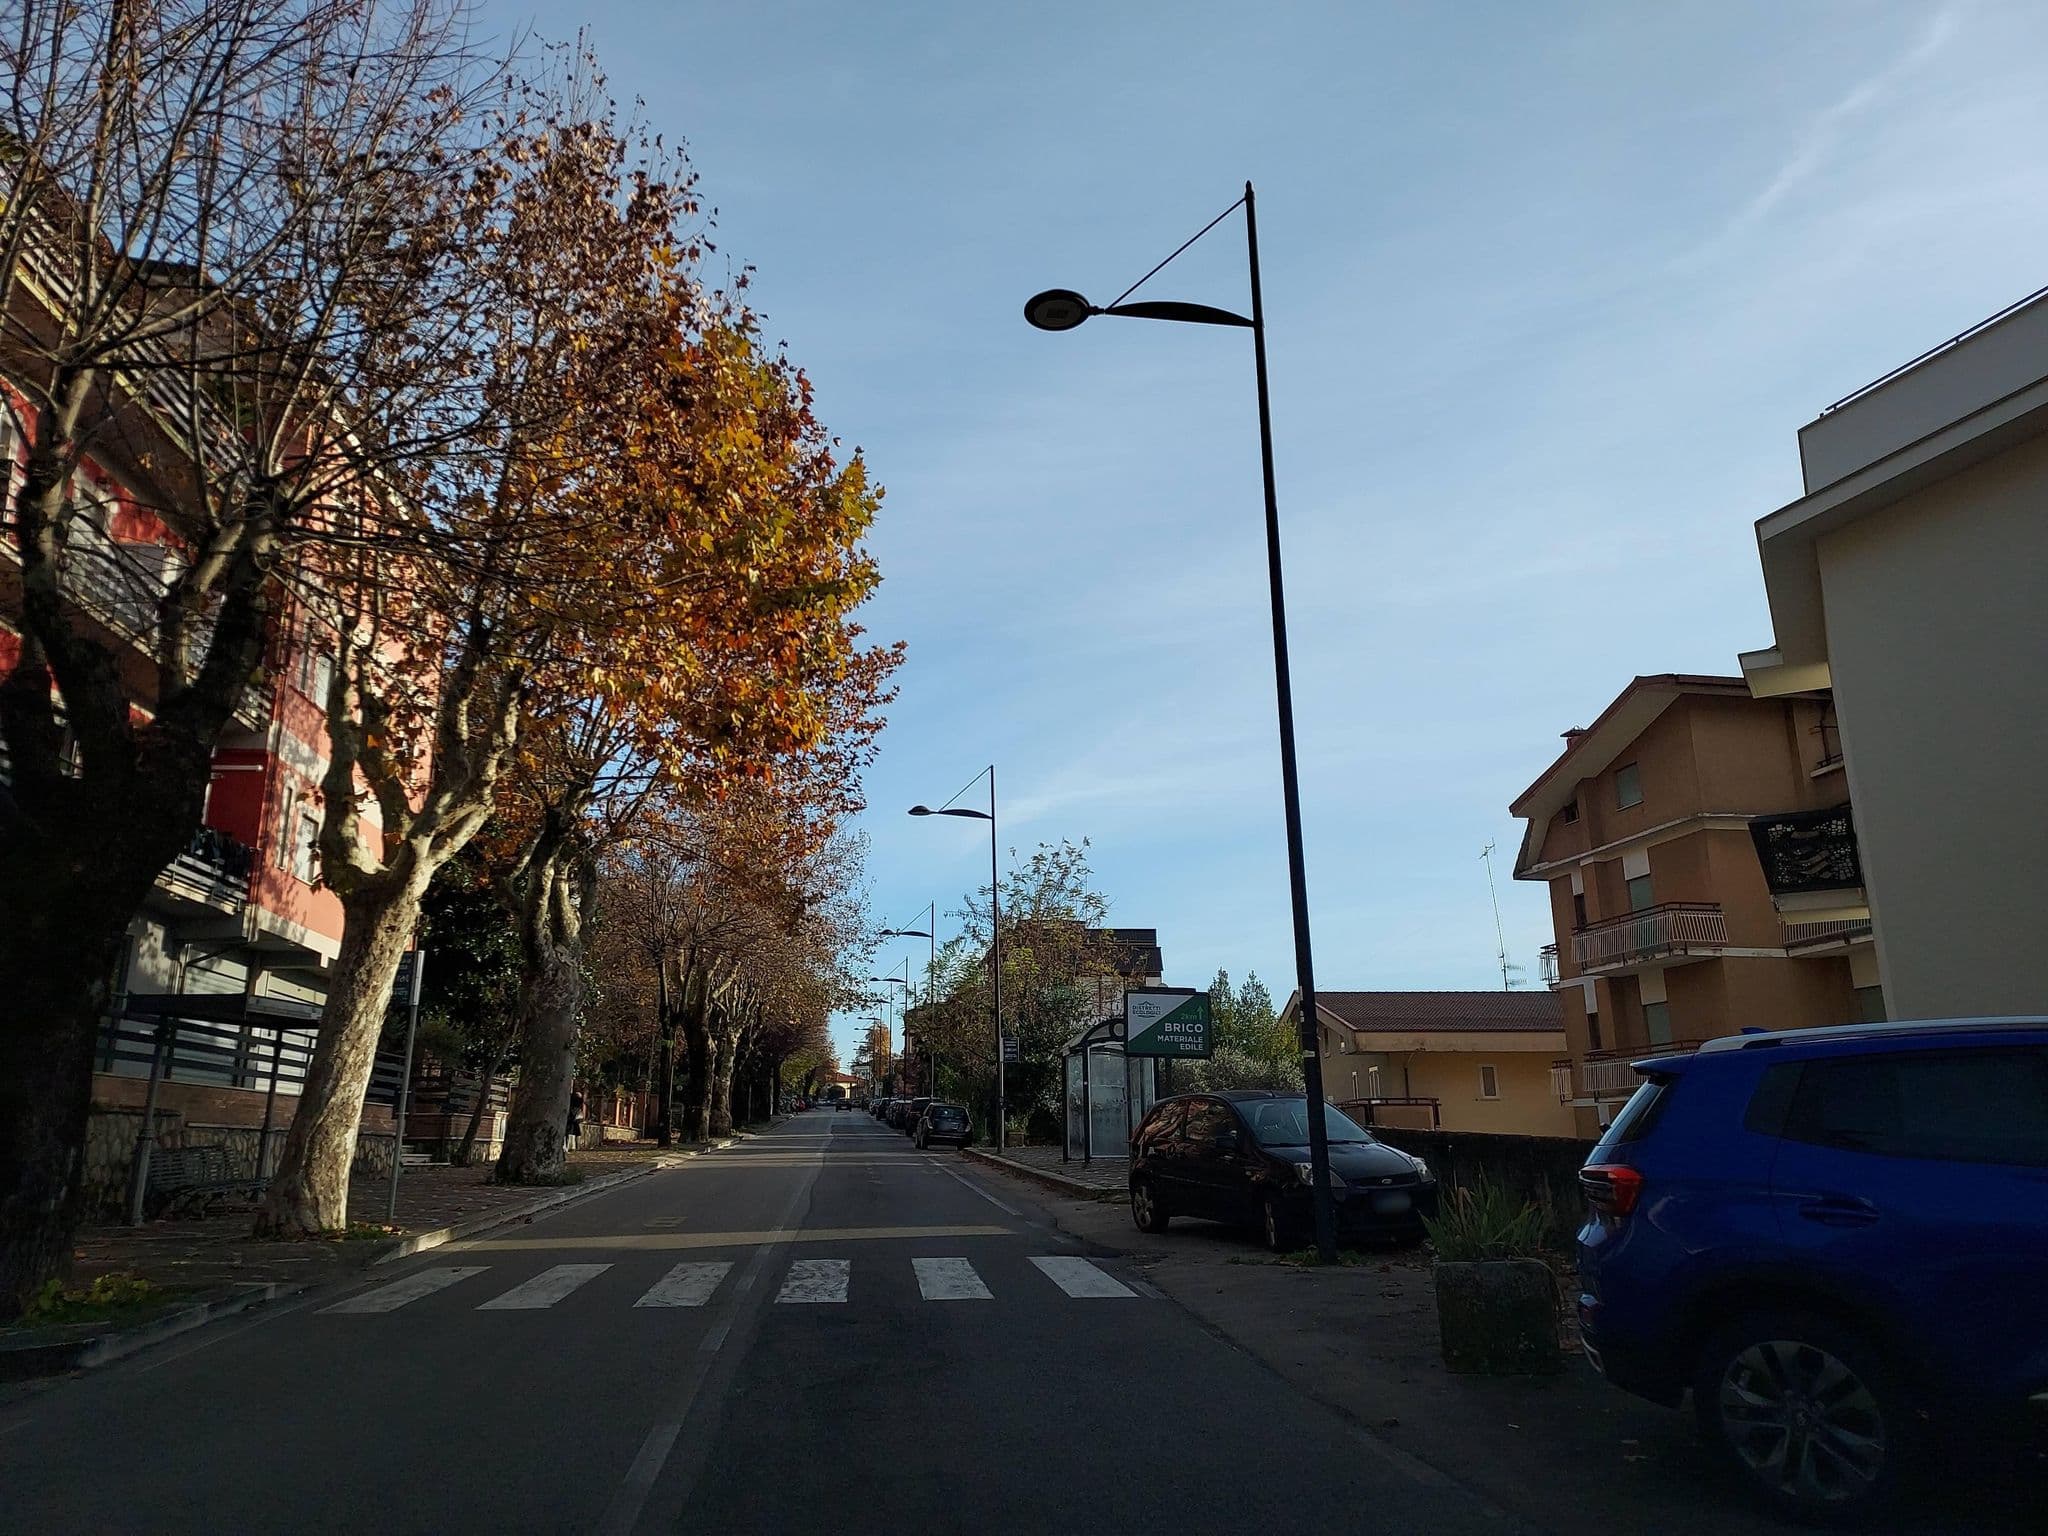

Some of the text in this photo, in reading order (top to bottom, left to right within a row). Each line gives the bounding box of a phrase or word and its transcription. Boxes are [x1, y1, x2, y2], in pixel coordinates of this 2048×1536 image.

[1164, 1022, 1204, 1033] BRICO
[1157, 1035, 1204, 1043] MATERIALE
[1180, 1043, 1204, 1051] EDILE
